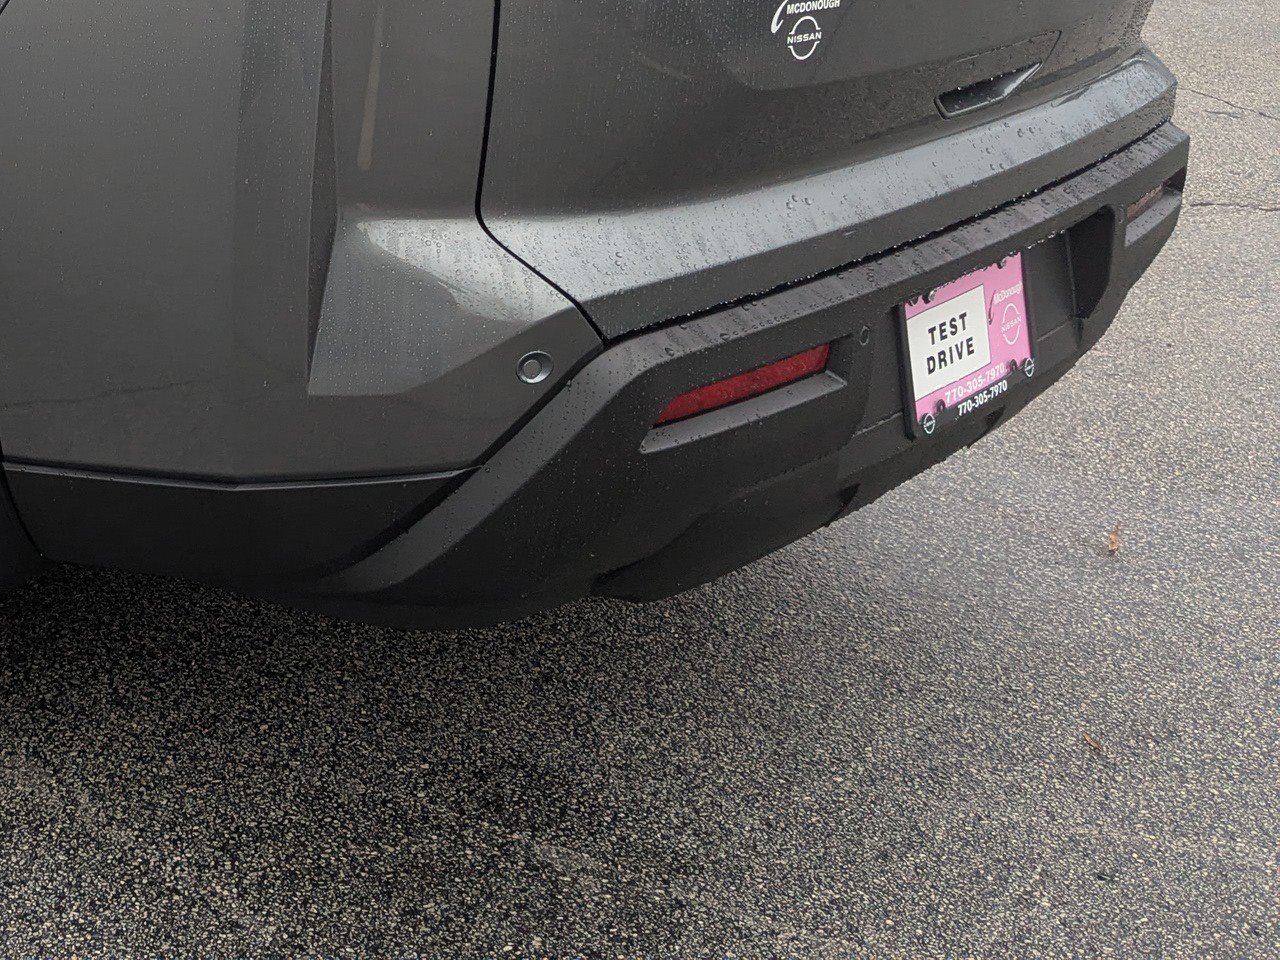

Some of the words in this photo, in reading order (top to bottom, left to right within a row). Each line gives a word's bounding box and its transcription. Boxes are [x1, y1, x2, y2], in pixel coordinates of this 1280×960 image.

[786, 32, 822, 44] NISSAN
[927, 312, 967, 345] TEST
[1001, 316, 1022, 333] NISSAN
[926, 337, 975, 375] DRIVE
[945, 362, 1006, 403] 770-305-7970
[957, 380, 1008, 416] 770-305-7970
